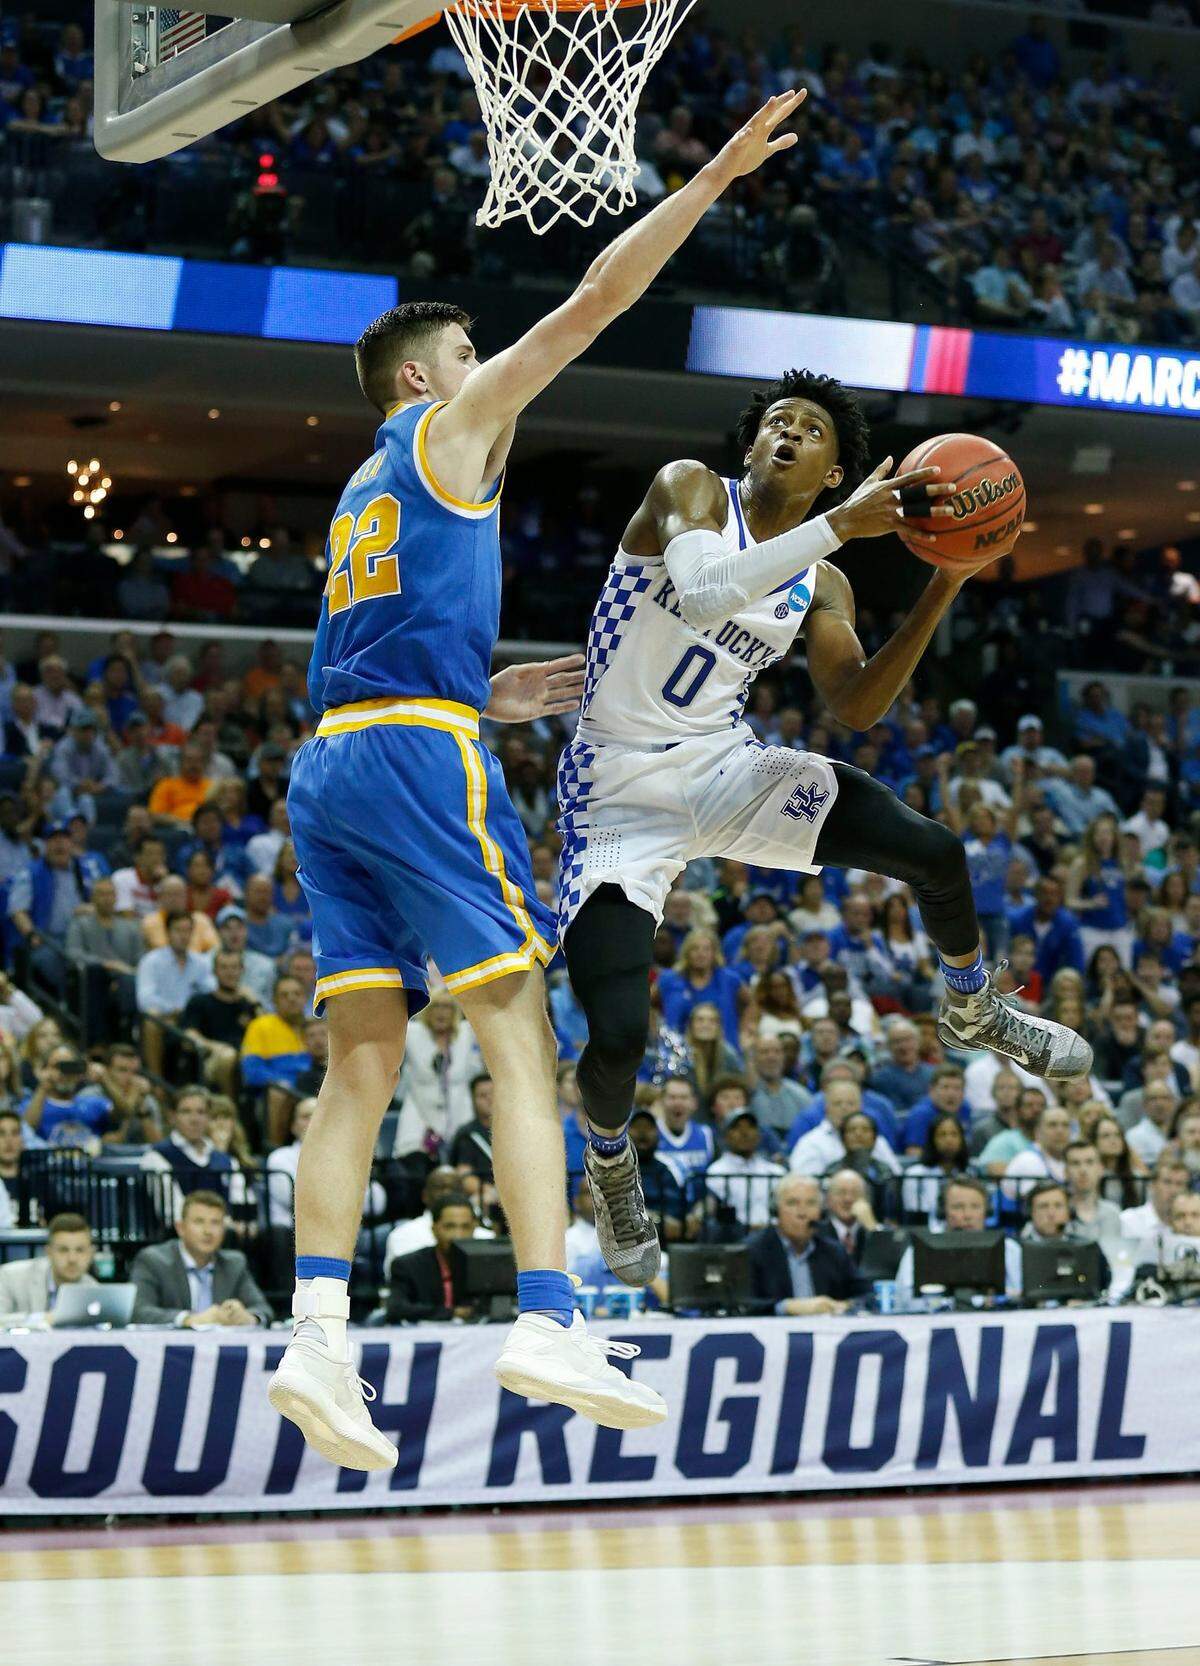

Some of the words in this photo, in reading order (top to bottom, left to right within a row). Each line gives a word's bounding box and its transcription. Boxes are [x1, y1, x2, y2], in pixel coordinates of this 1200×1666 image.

[945, 472, 1021, 520] Wilson
[324, 492, 401, 623] 22
[653, 576, 776, 666] KUCKY
[661, 644, 717, 708] 0
[780, 782, 830, 824] UK
[0, 1342, 442, 1498] OUH
[485, 1321, 1147, 1488] REGIONAL
